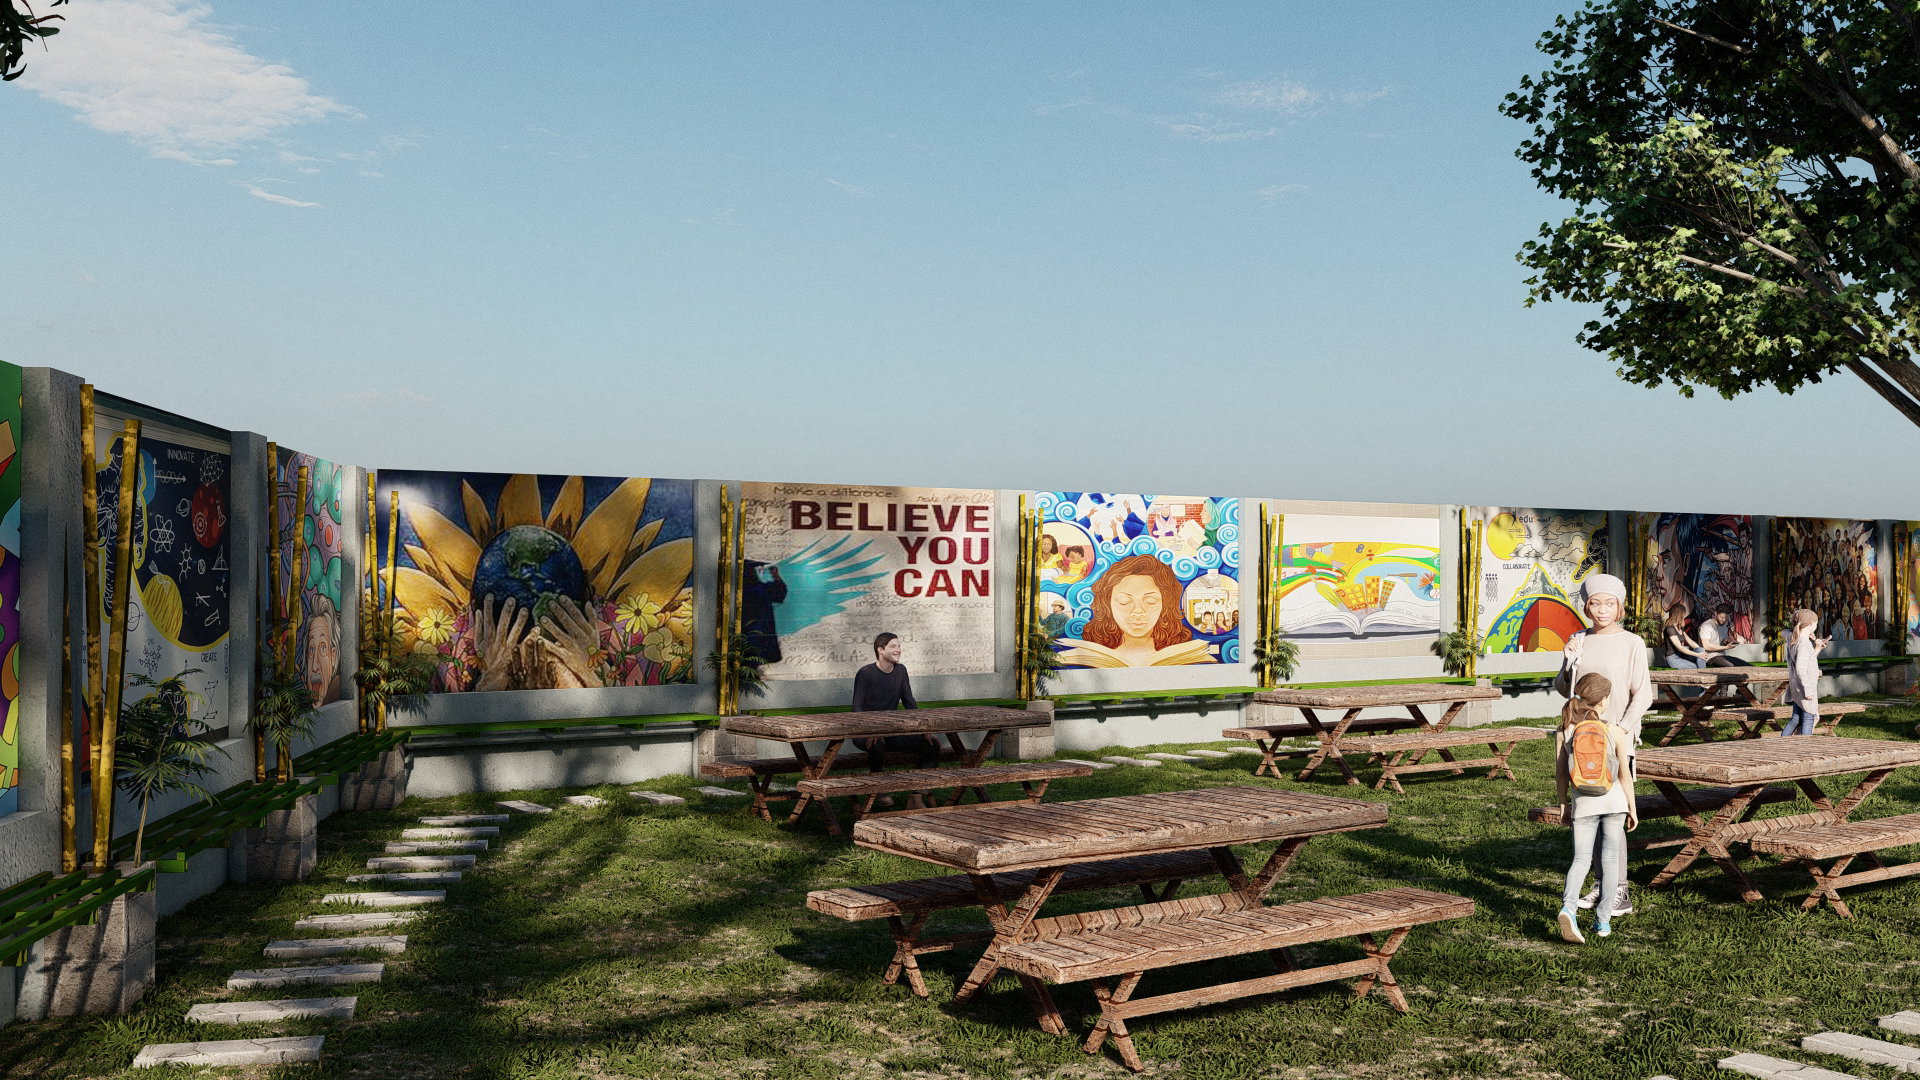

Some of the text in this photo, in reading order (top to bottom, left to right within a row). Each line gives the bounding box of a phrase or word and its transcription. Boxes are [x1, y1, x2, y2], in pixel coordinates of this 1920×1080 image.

[167, 448, 196, 464] INNOVATE
[773, 486, 813, 497] Make
[817, 489, 826, 497] a
[791, 501, 989, 531] BELIEVE
[897, 536, 989, 565] YOU
[894, 568, 989, 597] CAN
[200, 651, 218, 663] CREATE
